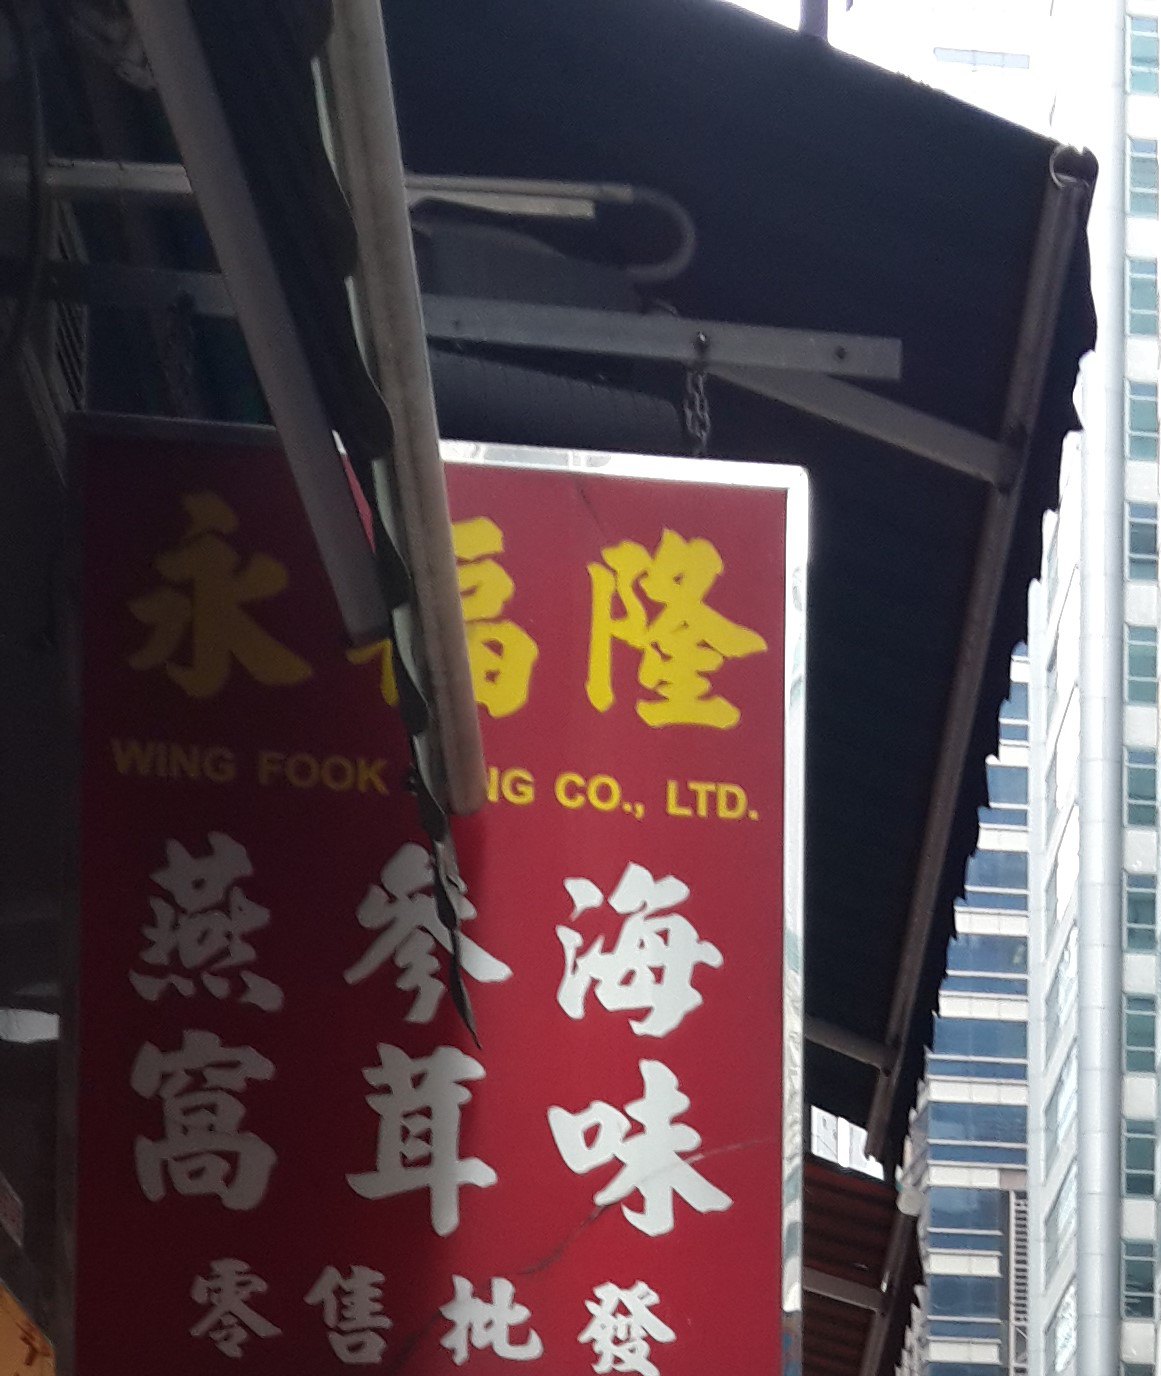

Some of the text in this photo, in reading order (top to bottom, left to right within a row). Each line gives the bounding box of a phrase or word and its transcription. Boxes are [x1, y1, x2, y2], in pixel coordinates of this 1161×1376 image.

[112, 737, 236, 781] WING
[257, 748, 389, 793] FOOK
[554, 773, 646, 817] CO.,
[666, 780, 760, 821] LTD.
[546, 861, 734, 1237] 海味
